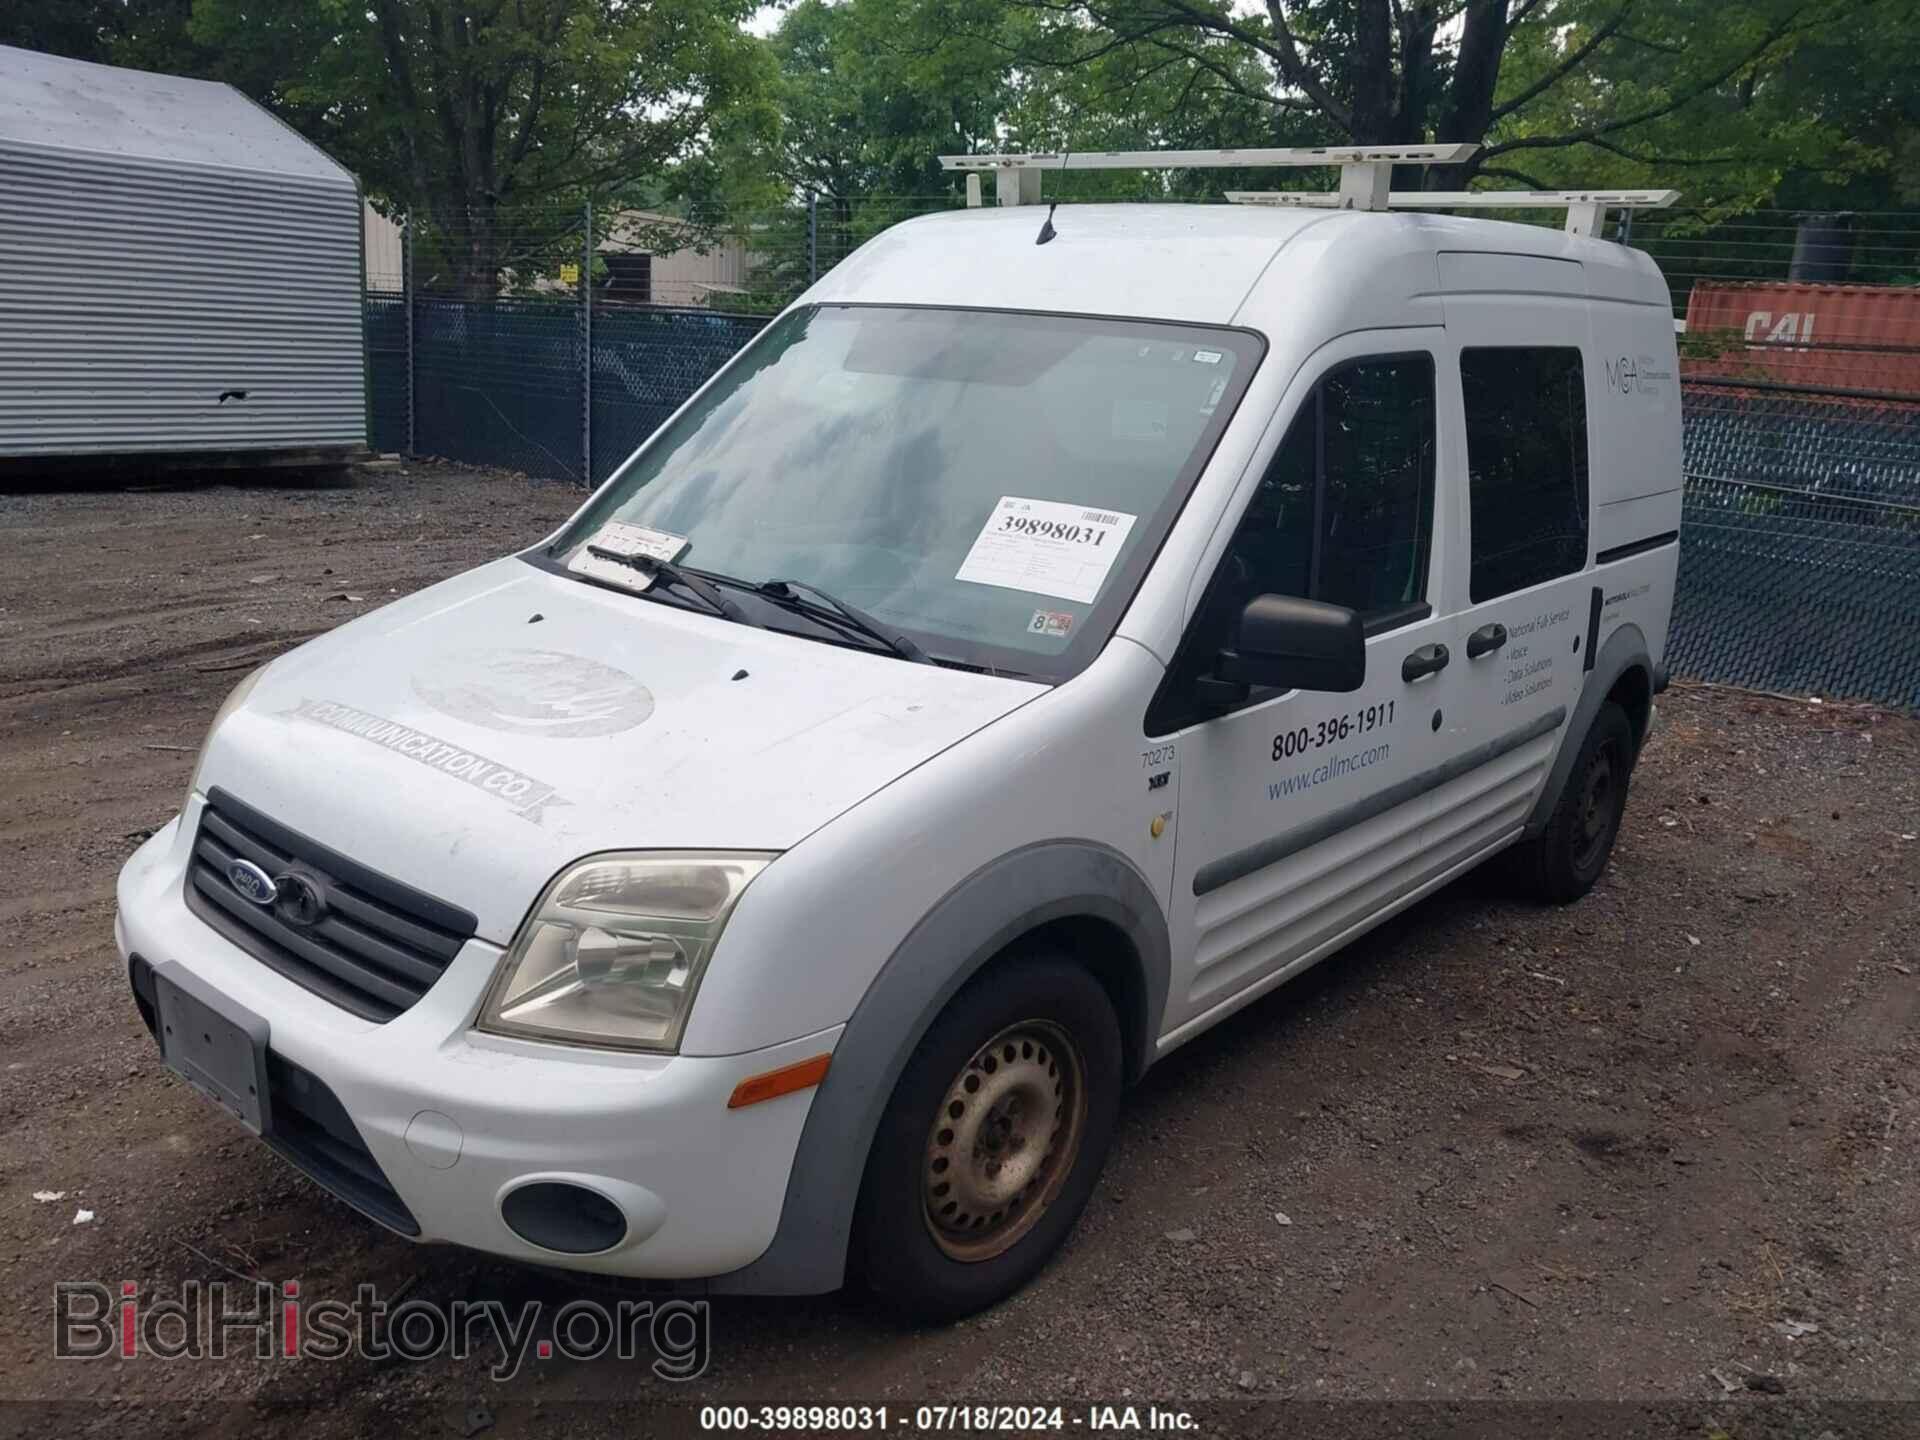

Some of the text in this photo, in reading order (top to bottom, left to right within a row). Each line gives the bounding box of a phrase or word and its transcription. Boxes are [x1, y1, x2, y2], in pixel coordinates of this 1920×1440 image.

[1744, 311, 1816, 352] CAI
[998, 515, 1106, 546] 39898031
[1033, 615, 1045, 629] 8
[1509, 619, 1536, 638] National
[1511, 647, 1528, 661] Voice
[1272, 700, 1395, 762] 800-396-1911
[1141, 744, 1175, 768] 70273
[1269, 743, 1390, 800] www.callmc.com
